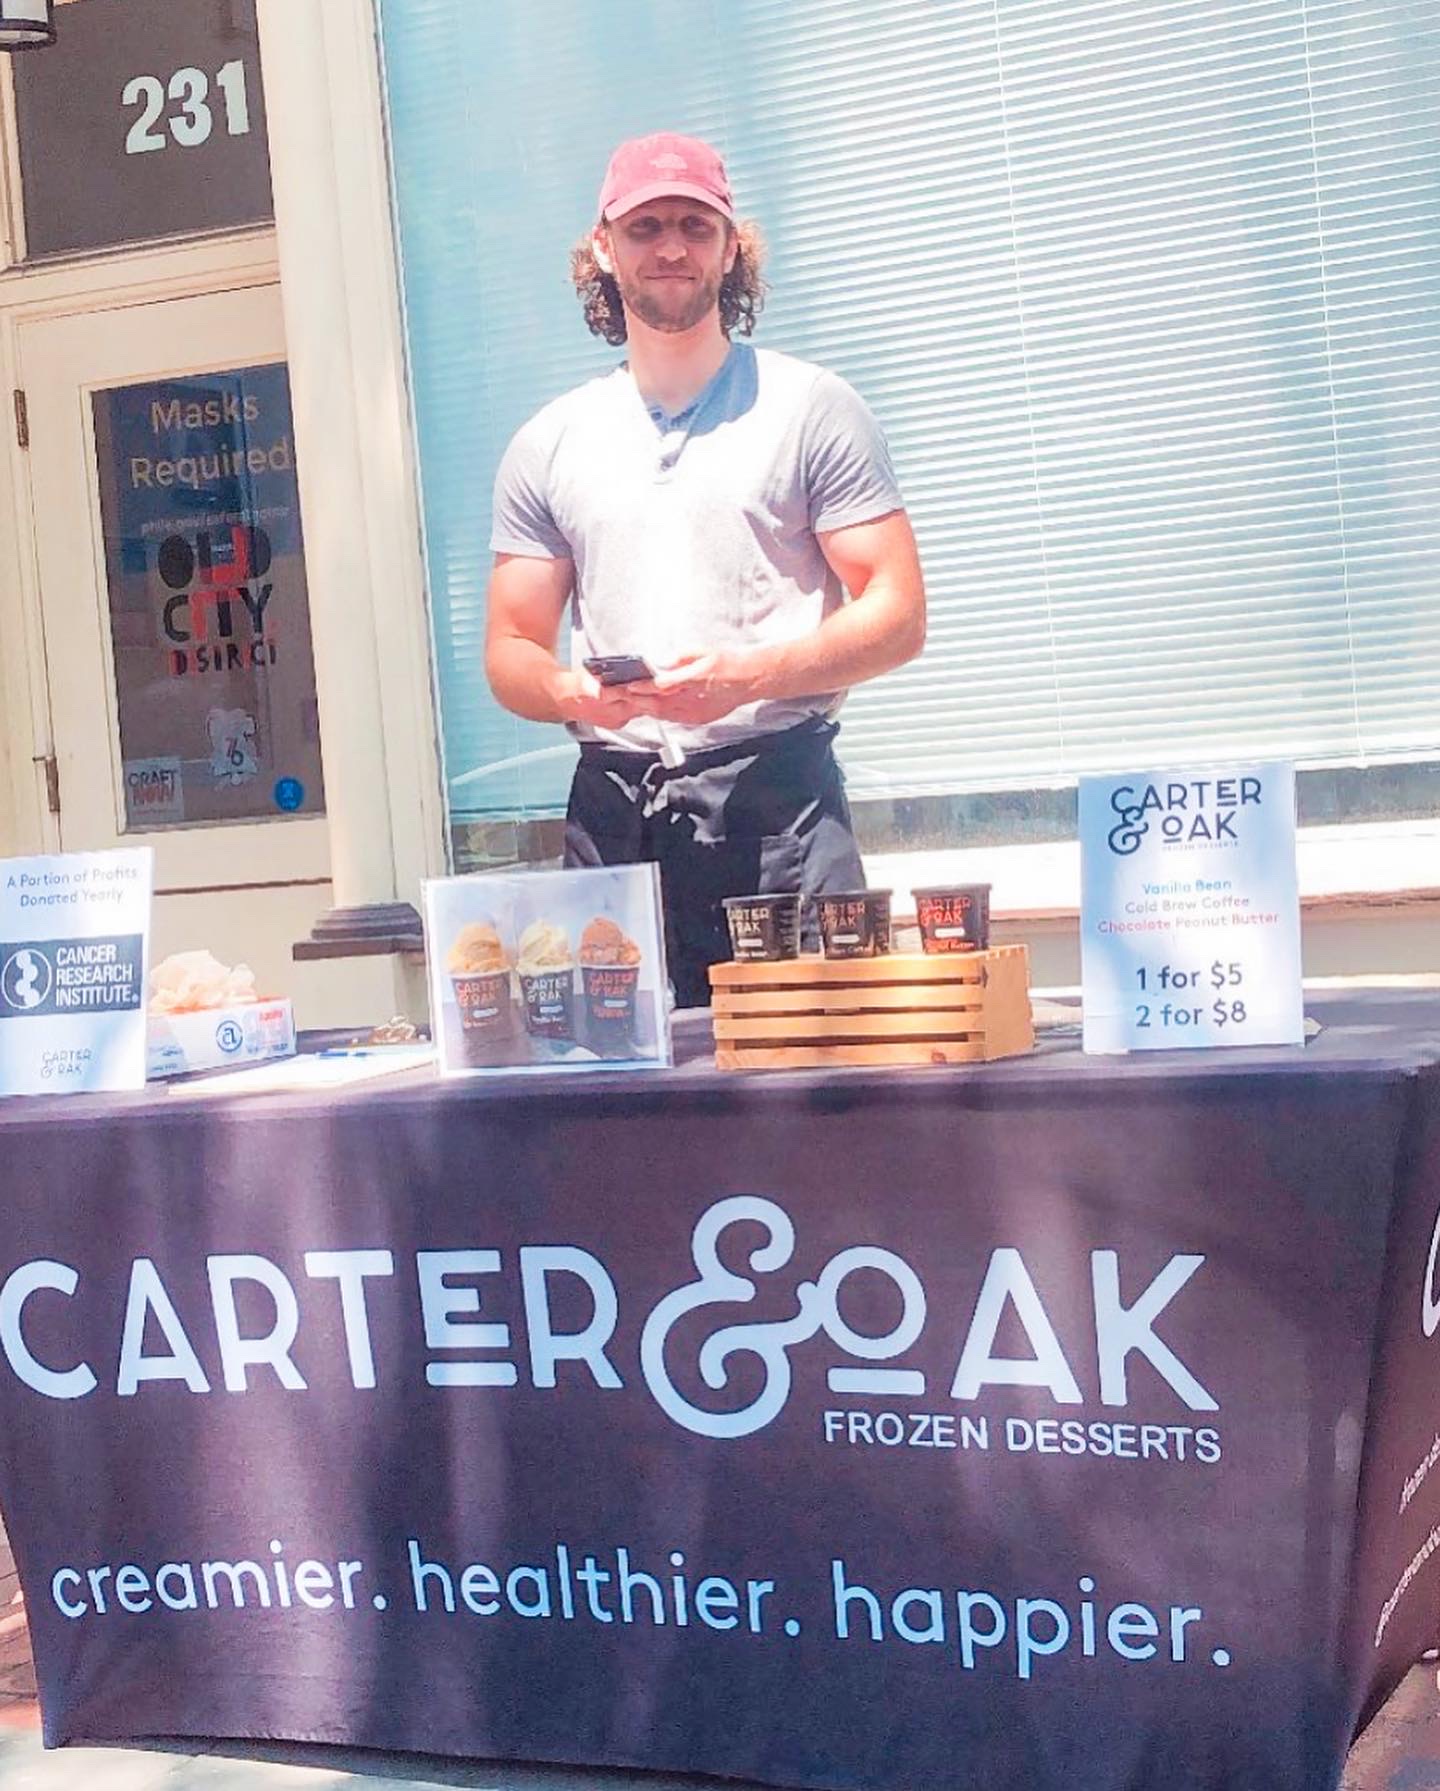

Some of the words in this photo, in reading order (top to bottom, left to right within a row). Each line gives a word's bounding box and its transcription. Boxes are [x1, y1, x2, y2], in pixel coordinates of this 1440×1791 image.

[122, 60, 250, 154] 231
[151, 390, 260, 433] Masks
[130, 437, 290, 490] Required
[163, 583, 273, 642] CITY
[1111, 778, 1262, 814] CARTER
[1108, 805, 1149, 856] &
[1161, 811, 1239, 844] OAK
[7, 875, 17, 889] A
[20, 871, 70, 888] Portion
[74, 870, 88, 884] of
[92, 866, 138, 882] Profits
[1143, 881, 1191, 896] Vanilla
[1195, 879, 1232, 892] Bean
[20, 891, 78, 908] Donated
[82, 889, 124, 905] Yearly
[1125, 900, 1158, 915] Cold
[1162, 898, 1197, 912] Brew
[1201, 895, 1250, 910] Coffee
[1097, 918, 1171, 934] Chocolate
[1175, 914, 1227, 929] Peanut
[1231, 911, 1279, 926] Butter
[56, 944, 117, 967] CANCER
[56, 963, 134, 987] RESEARCH
[1136, 967, 1147, 991] 1
[1157, 965, 1201, 990] for
[1210, 960, 1243, 990] $5
[1136, 1004, 1151, 1028] 2
[1160, 1002, 1204, 1027] for
[1212, 998, 1248, 1028] $8
[0, 1244, 624, 1400] CARTER
[640, 1195, 816, 1439] &
[816, 1245, 1220, 1412] OAK
[824, 1411, 989, 1450] FROZEN
[1006, 1417, 1221, 1463] DESSERTS
[52, 1540, 386, 1618] creamier.
[407, 1539, 800, 1639] healthier.
[832, 1560, 1231, 1679] happier.
